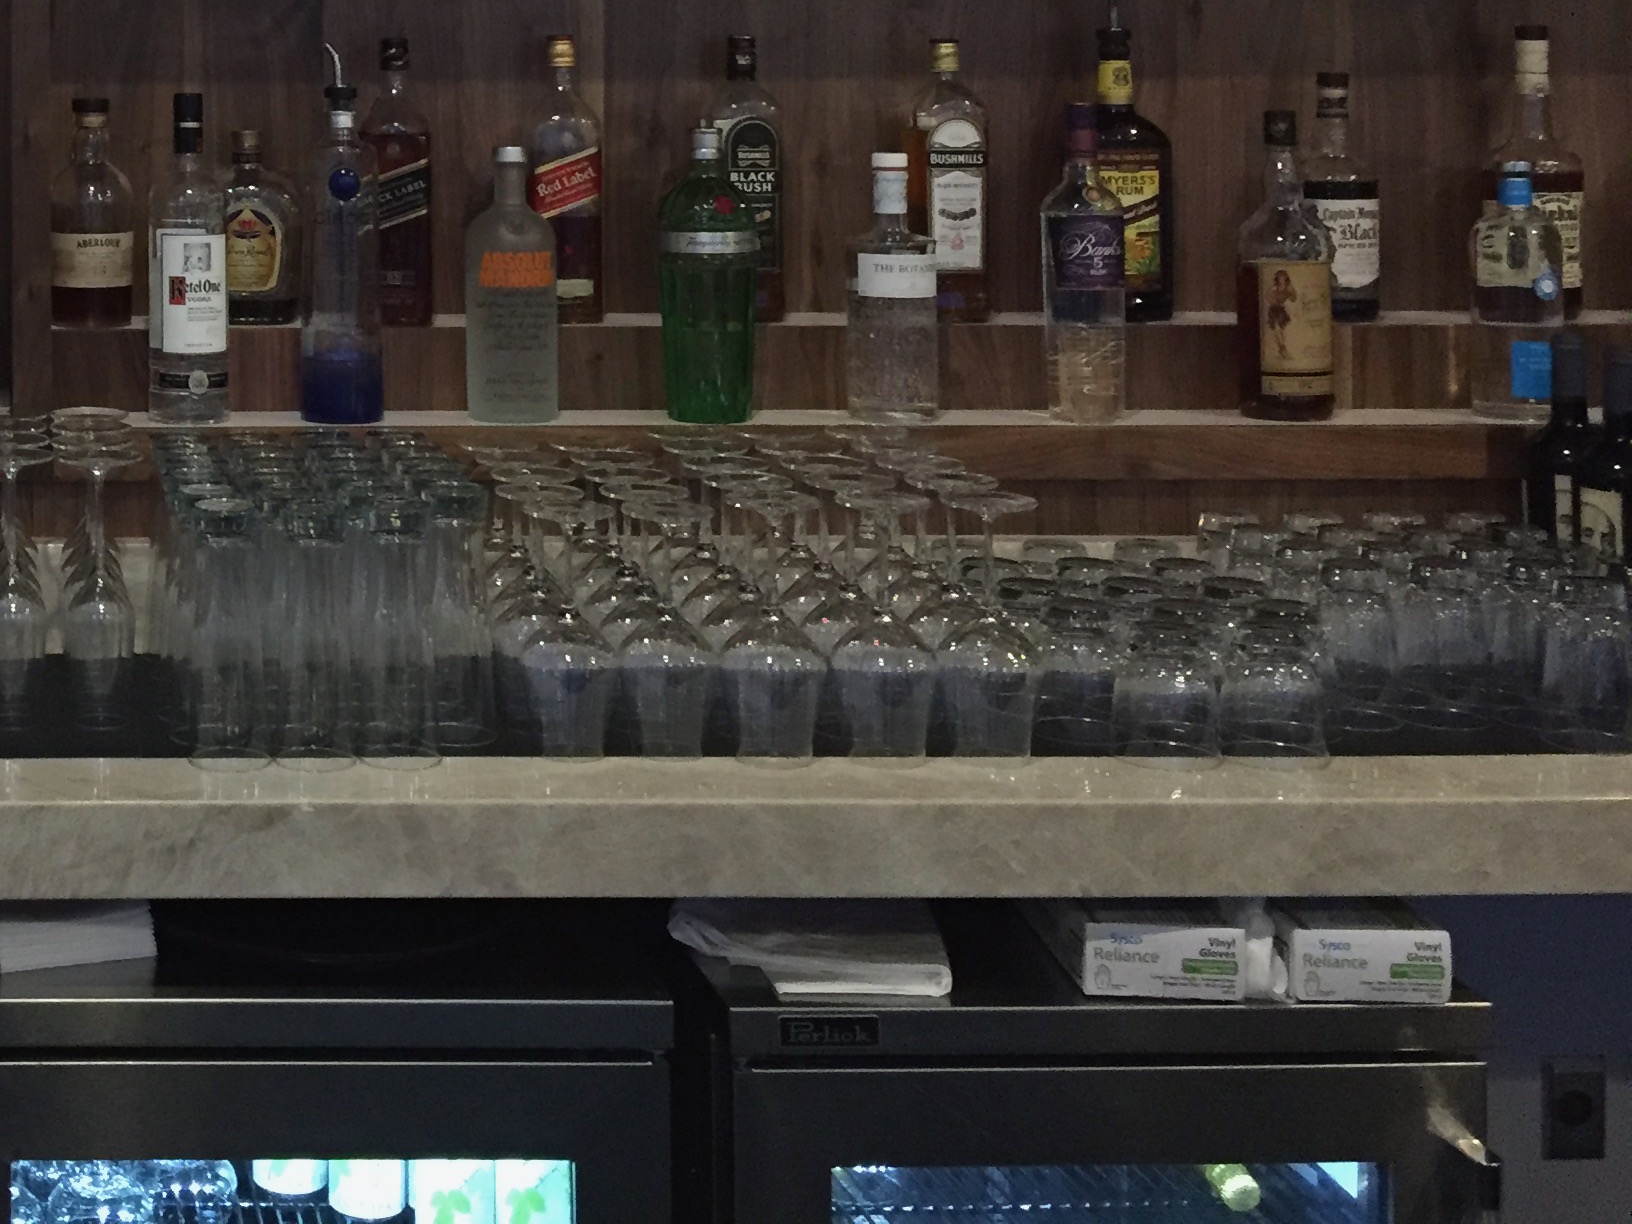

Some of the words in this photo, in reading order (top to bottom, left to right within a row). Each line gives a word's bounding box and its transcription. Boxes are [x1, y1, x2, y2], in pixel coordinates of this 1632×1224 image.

[929, 152, 985, 165] BUSHMILLS
[535, 178, 563, 198] Red
[562, 166, 598, 188] Label
[729, 171, 776, 183] BLACK
[1116, 186, 1145, 197] RUM
[1093, 256, 1104, 268] 5
[1207, 937, 1237, 949] Vinyl
[1414, 941, 1443, 953] Vinyl
[1093, 946, 1161, 964] Reliance
[1199, 948, 1237, 959] Gloves
[1406, 952, 1443, 963] Gloves
[1302, 953, 1369, 970] Reliance
